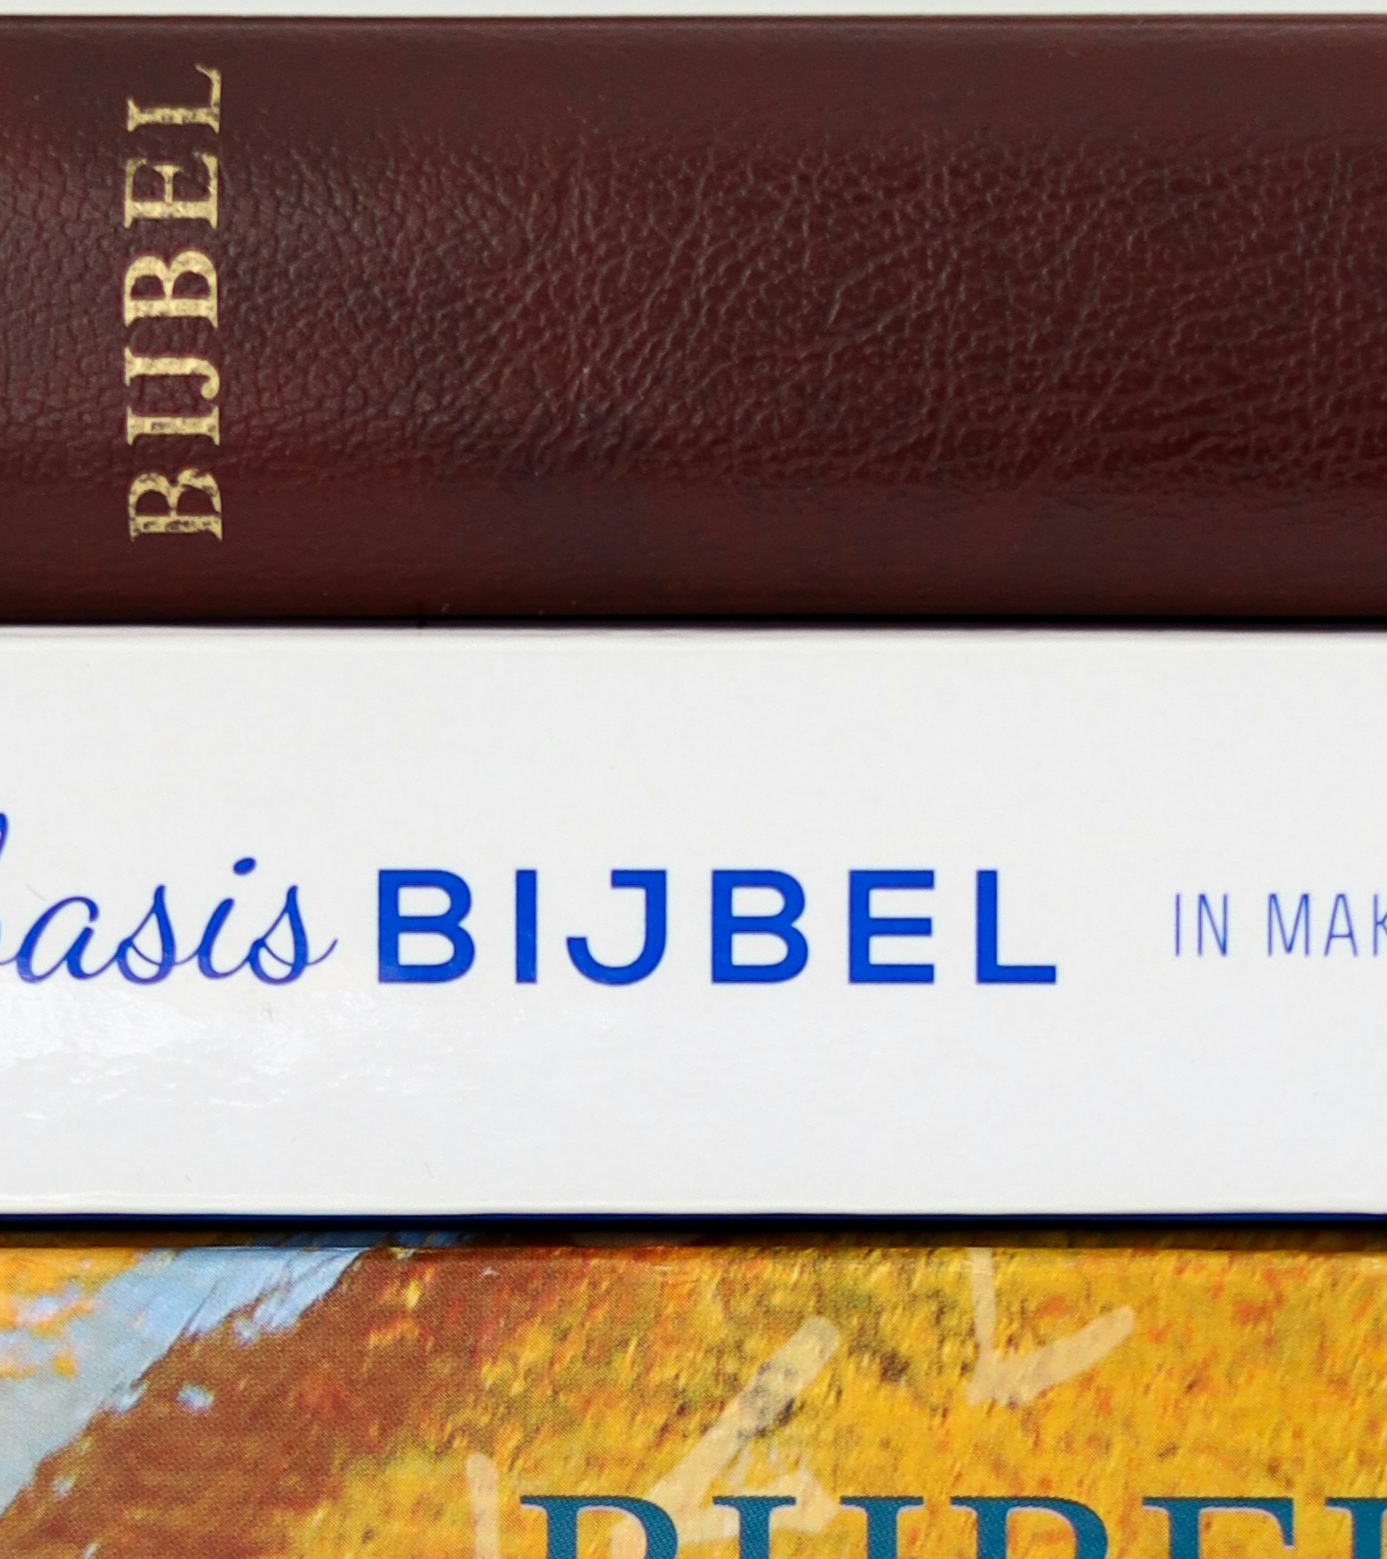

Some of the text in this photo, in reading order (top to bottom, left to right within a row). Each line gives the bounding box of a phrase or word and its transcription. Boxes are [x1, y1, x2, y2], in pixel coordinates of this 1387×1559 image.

[123, 64, 222, 540] BIJBEL
[377, 869, 1058, 985] BIJBEL
[1174, 893, 1229, 958] IN
